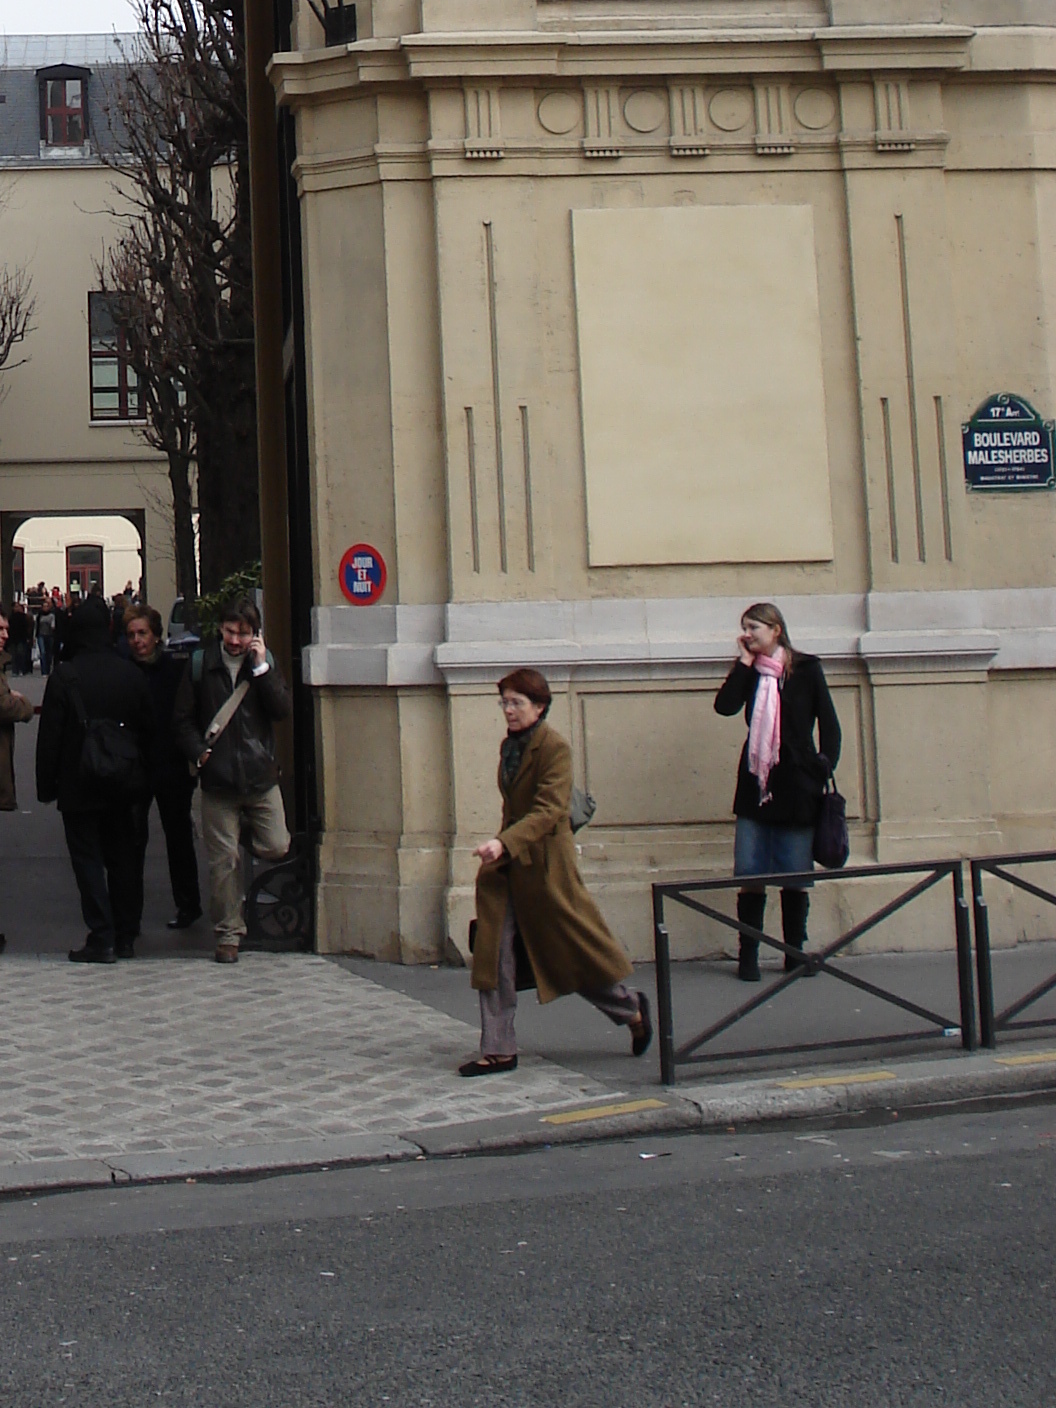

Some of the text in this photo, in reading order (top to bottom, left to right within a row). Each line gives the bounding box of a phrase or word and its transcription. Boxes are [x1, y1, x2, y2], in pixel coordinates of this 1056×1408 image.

[973, 431, 1041, 448] BOULEVARD
[967, 448, 1049, 465] MALESHERBES
[351, 557, 373, 569] JOUR
[357, 569, 367, 581] ET
[353, 581, 372, 593] NUIT
